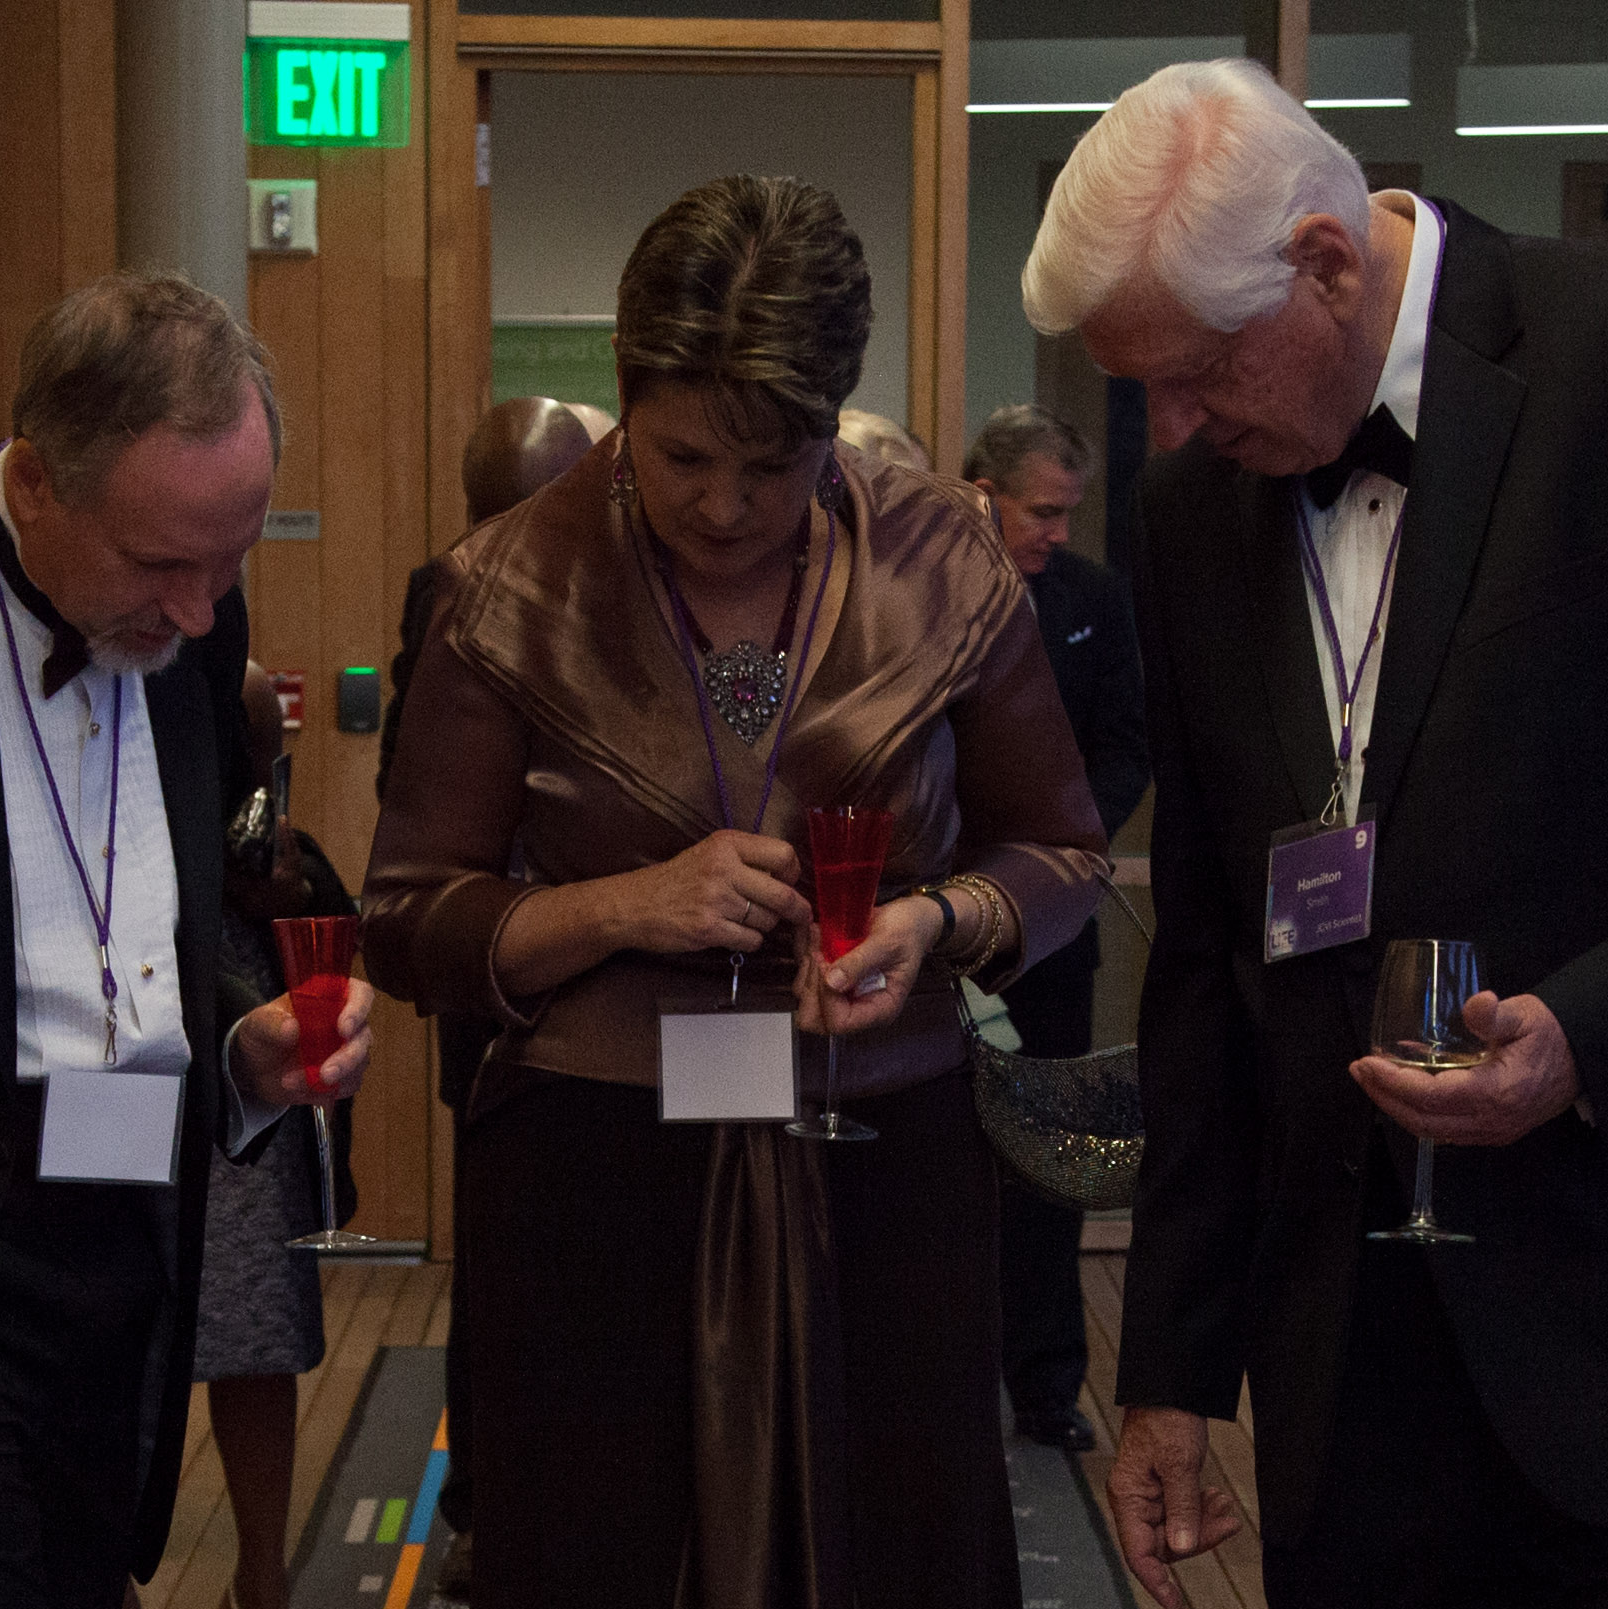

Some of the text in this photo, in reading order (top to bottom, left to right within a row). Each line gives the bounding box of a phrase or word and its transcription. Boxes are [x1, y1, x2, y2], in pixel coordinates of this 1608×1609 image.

[276, 49, 387, 137] EXIT
[1354, 830, 1368, 850] 9
[1296, 870, 1342, 893] Hamilton
